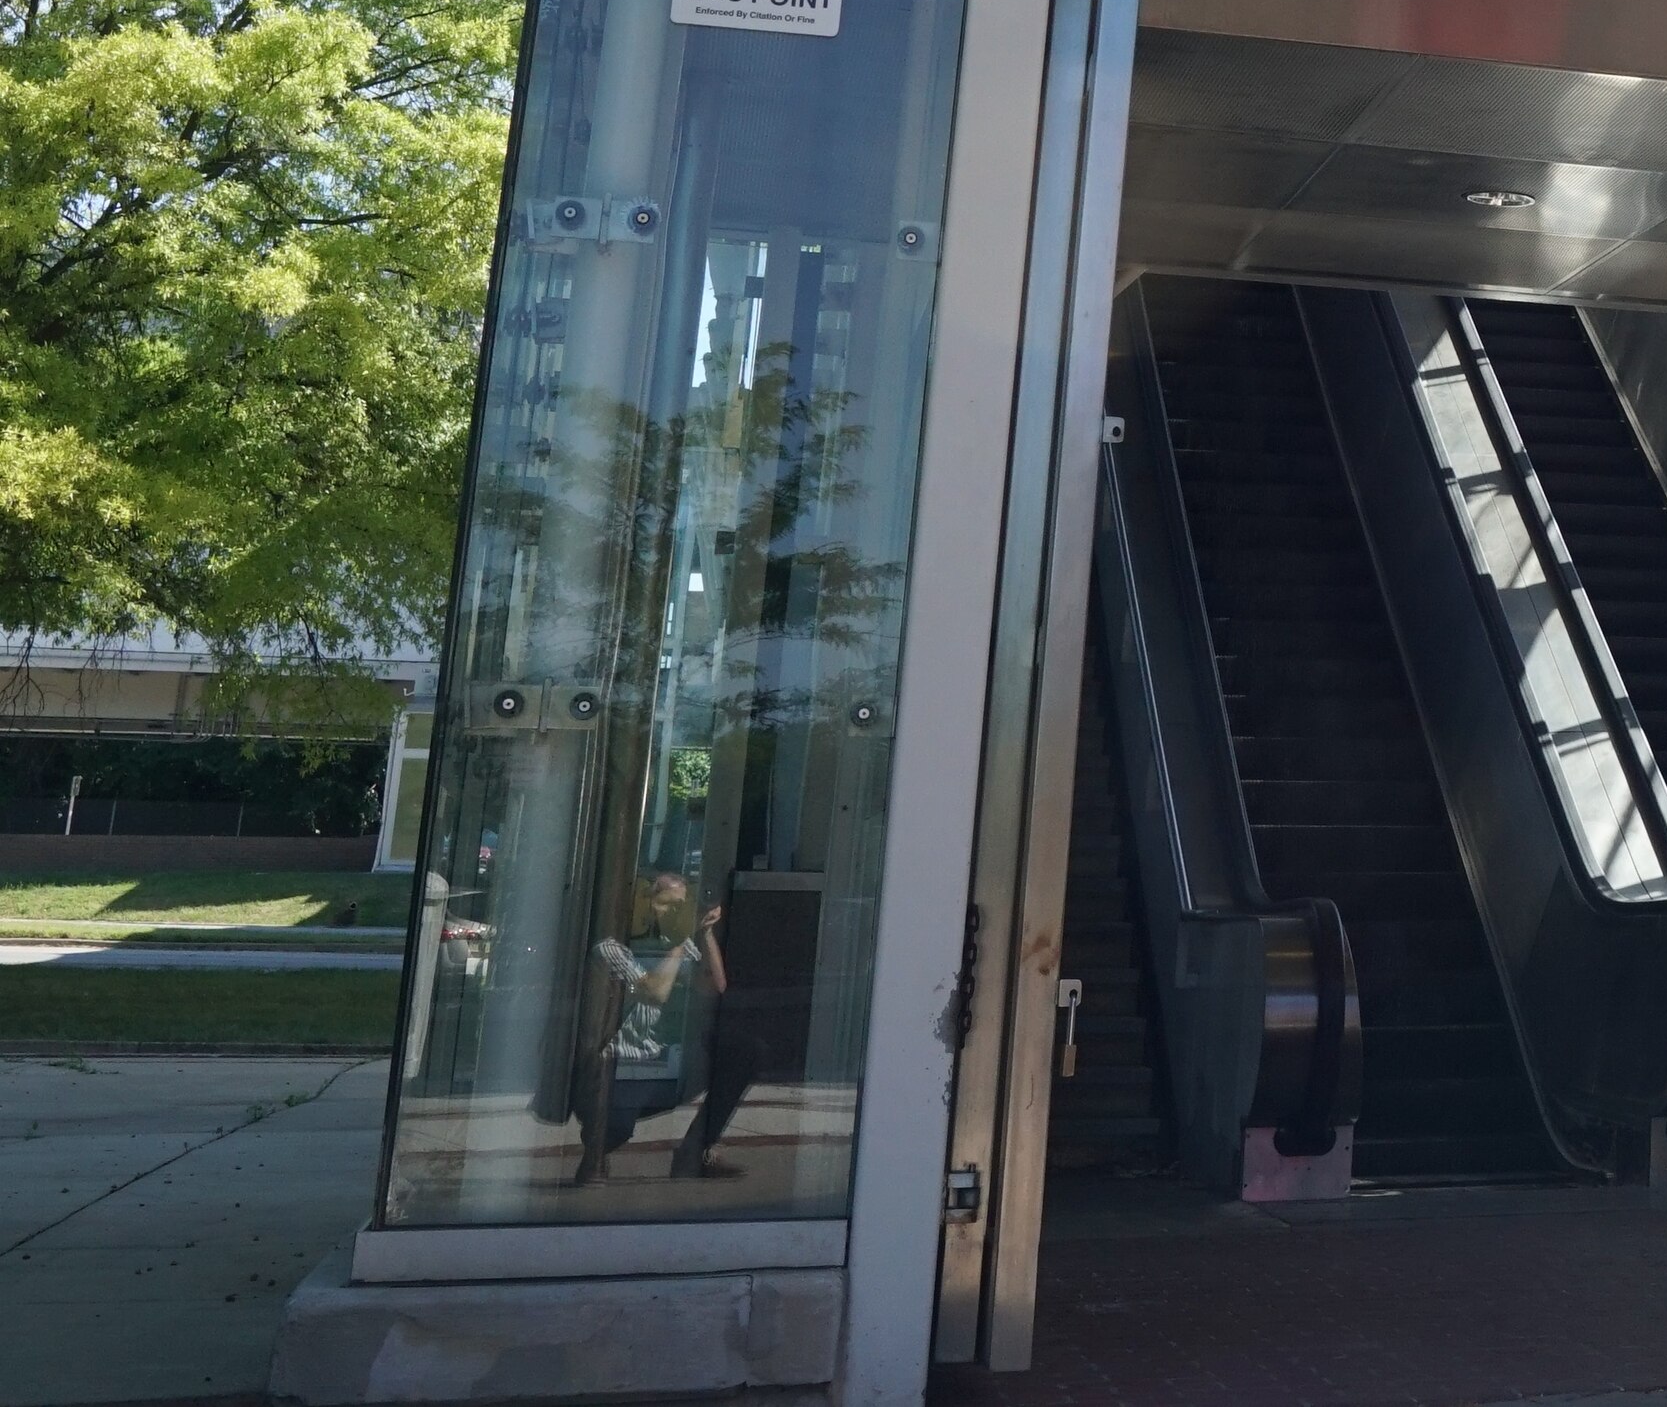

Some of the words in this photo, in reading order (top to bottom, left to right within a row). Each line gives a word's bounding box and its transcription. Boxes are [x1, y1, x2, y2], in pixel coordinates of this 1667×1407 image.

[695, 6, 735, 17] Enforced
[736, 9, 748, 20] By
[749, 11, 783, 22] Citation
[784, 14, 796, 23] Or
[797, 15, 816, 25] Fine
